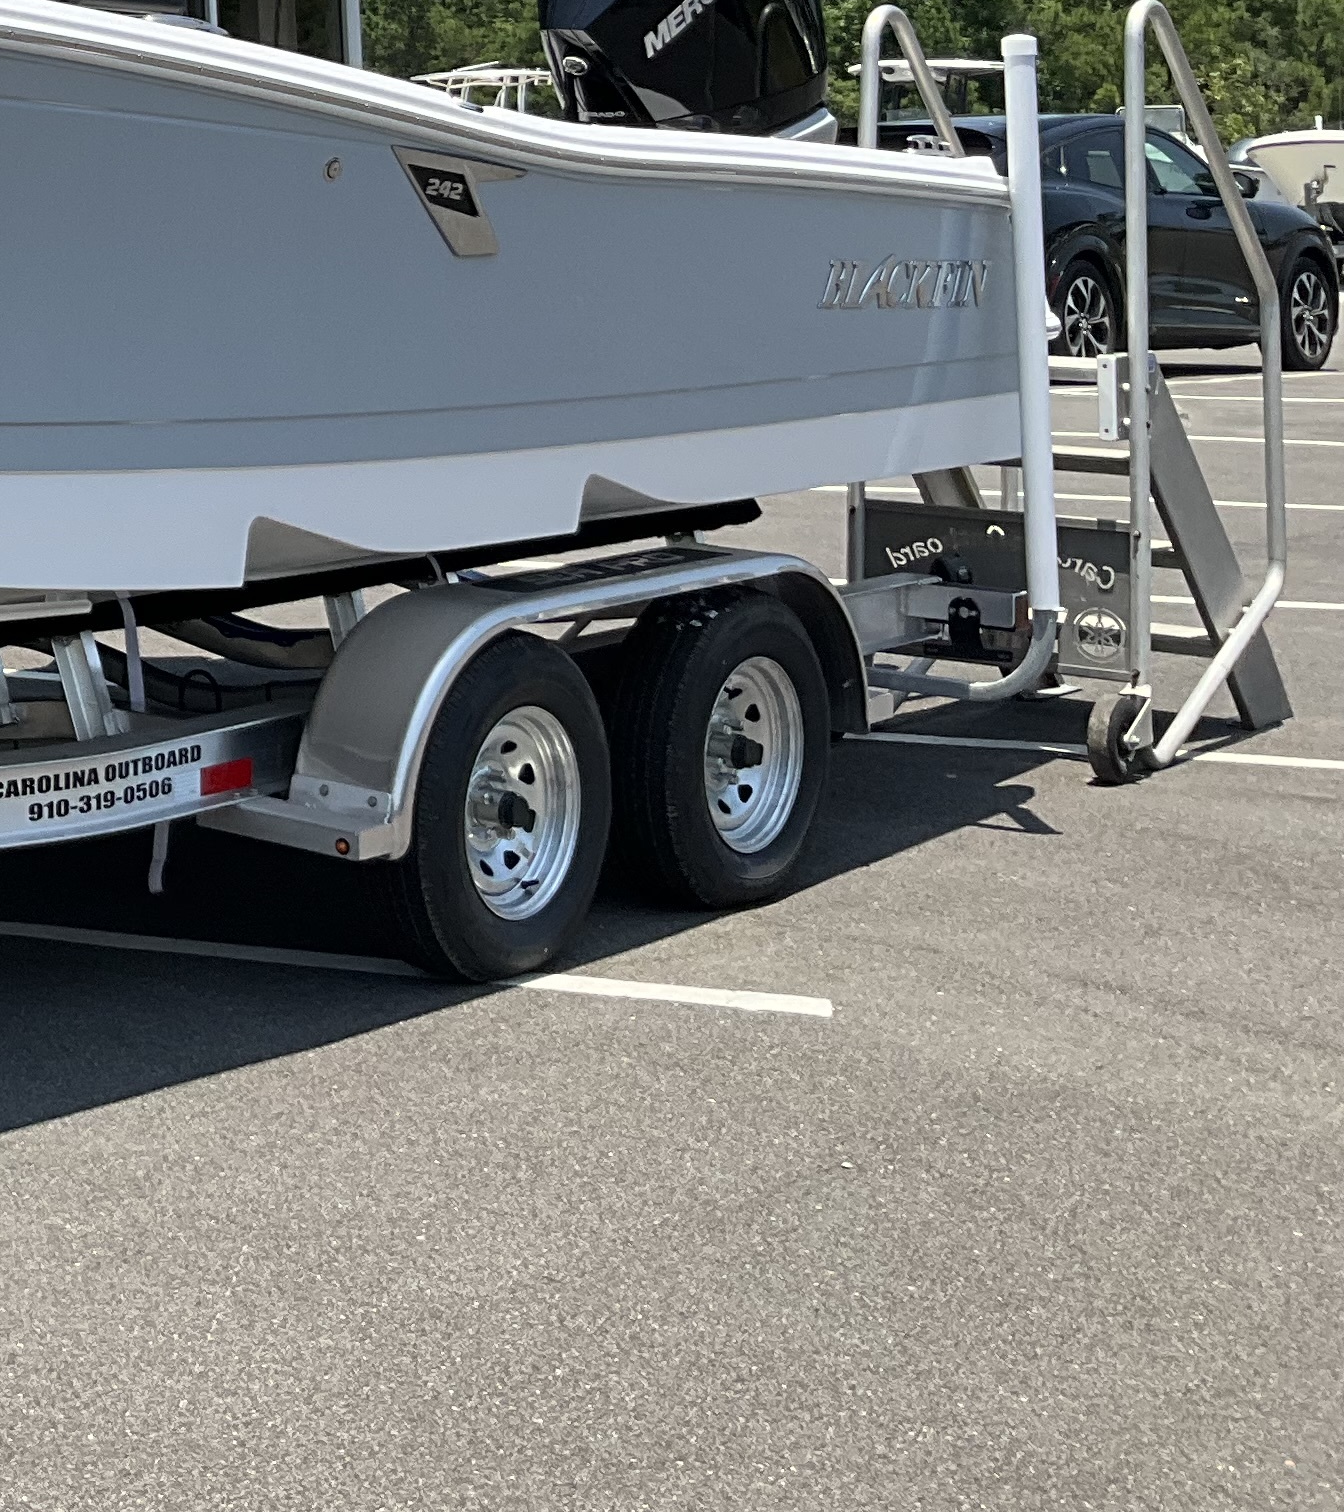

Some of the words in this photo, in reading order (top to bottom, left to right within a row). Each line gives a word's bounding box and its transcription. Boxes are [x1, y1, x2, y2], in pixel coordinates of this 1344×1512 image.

[425, 178, 463, 200] 242
[817, 253, 992, 309] BLACKFIN
[104, 744, 202, 782] OUTBOARD
[28, 776, 173, 821] 910-319-0506
